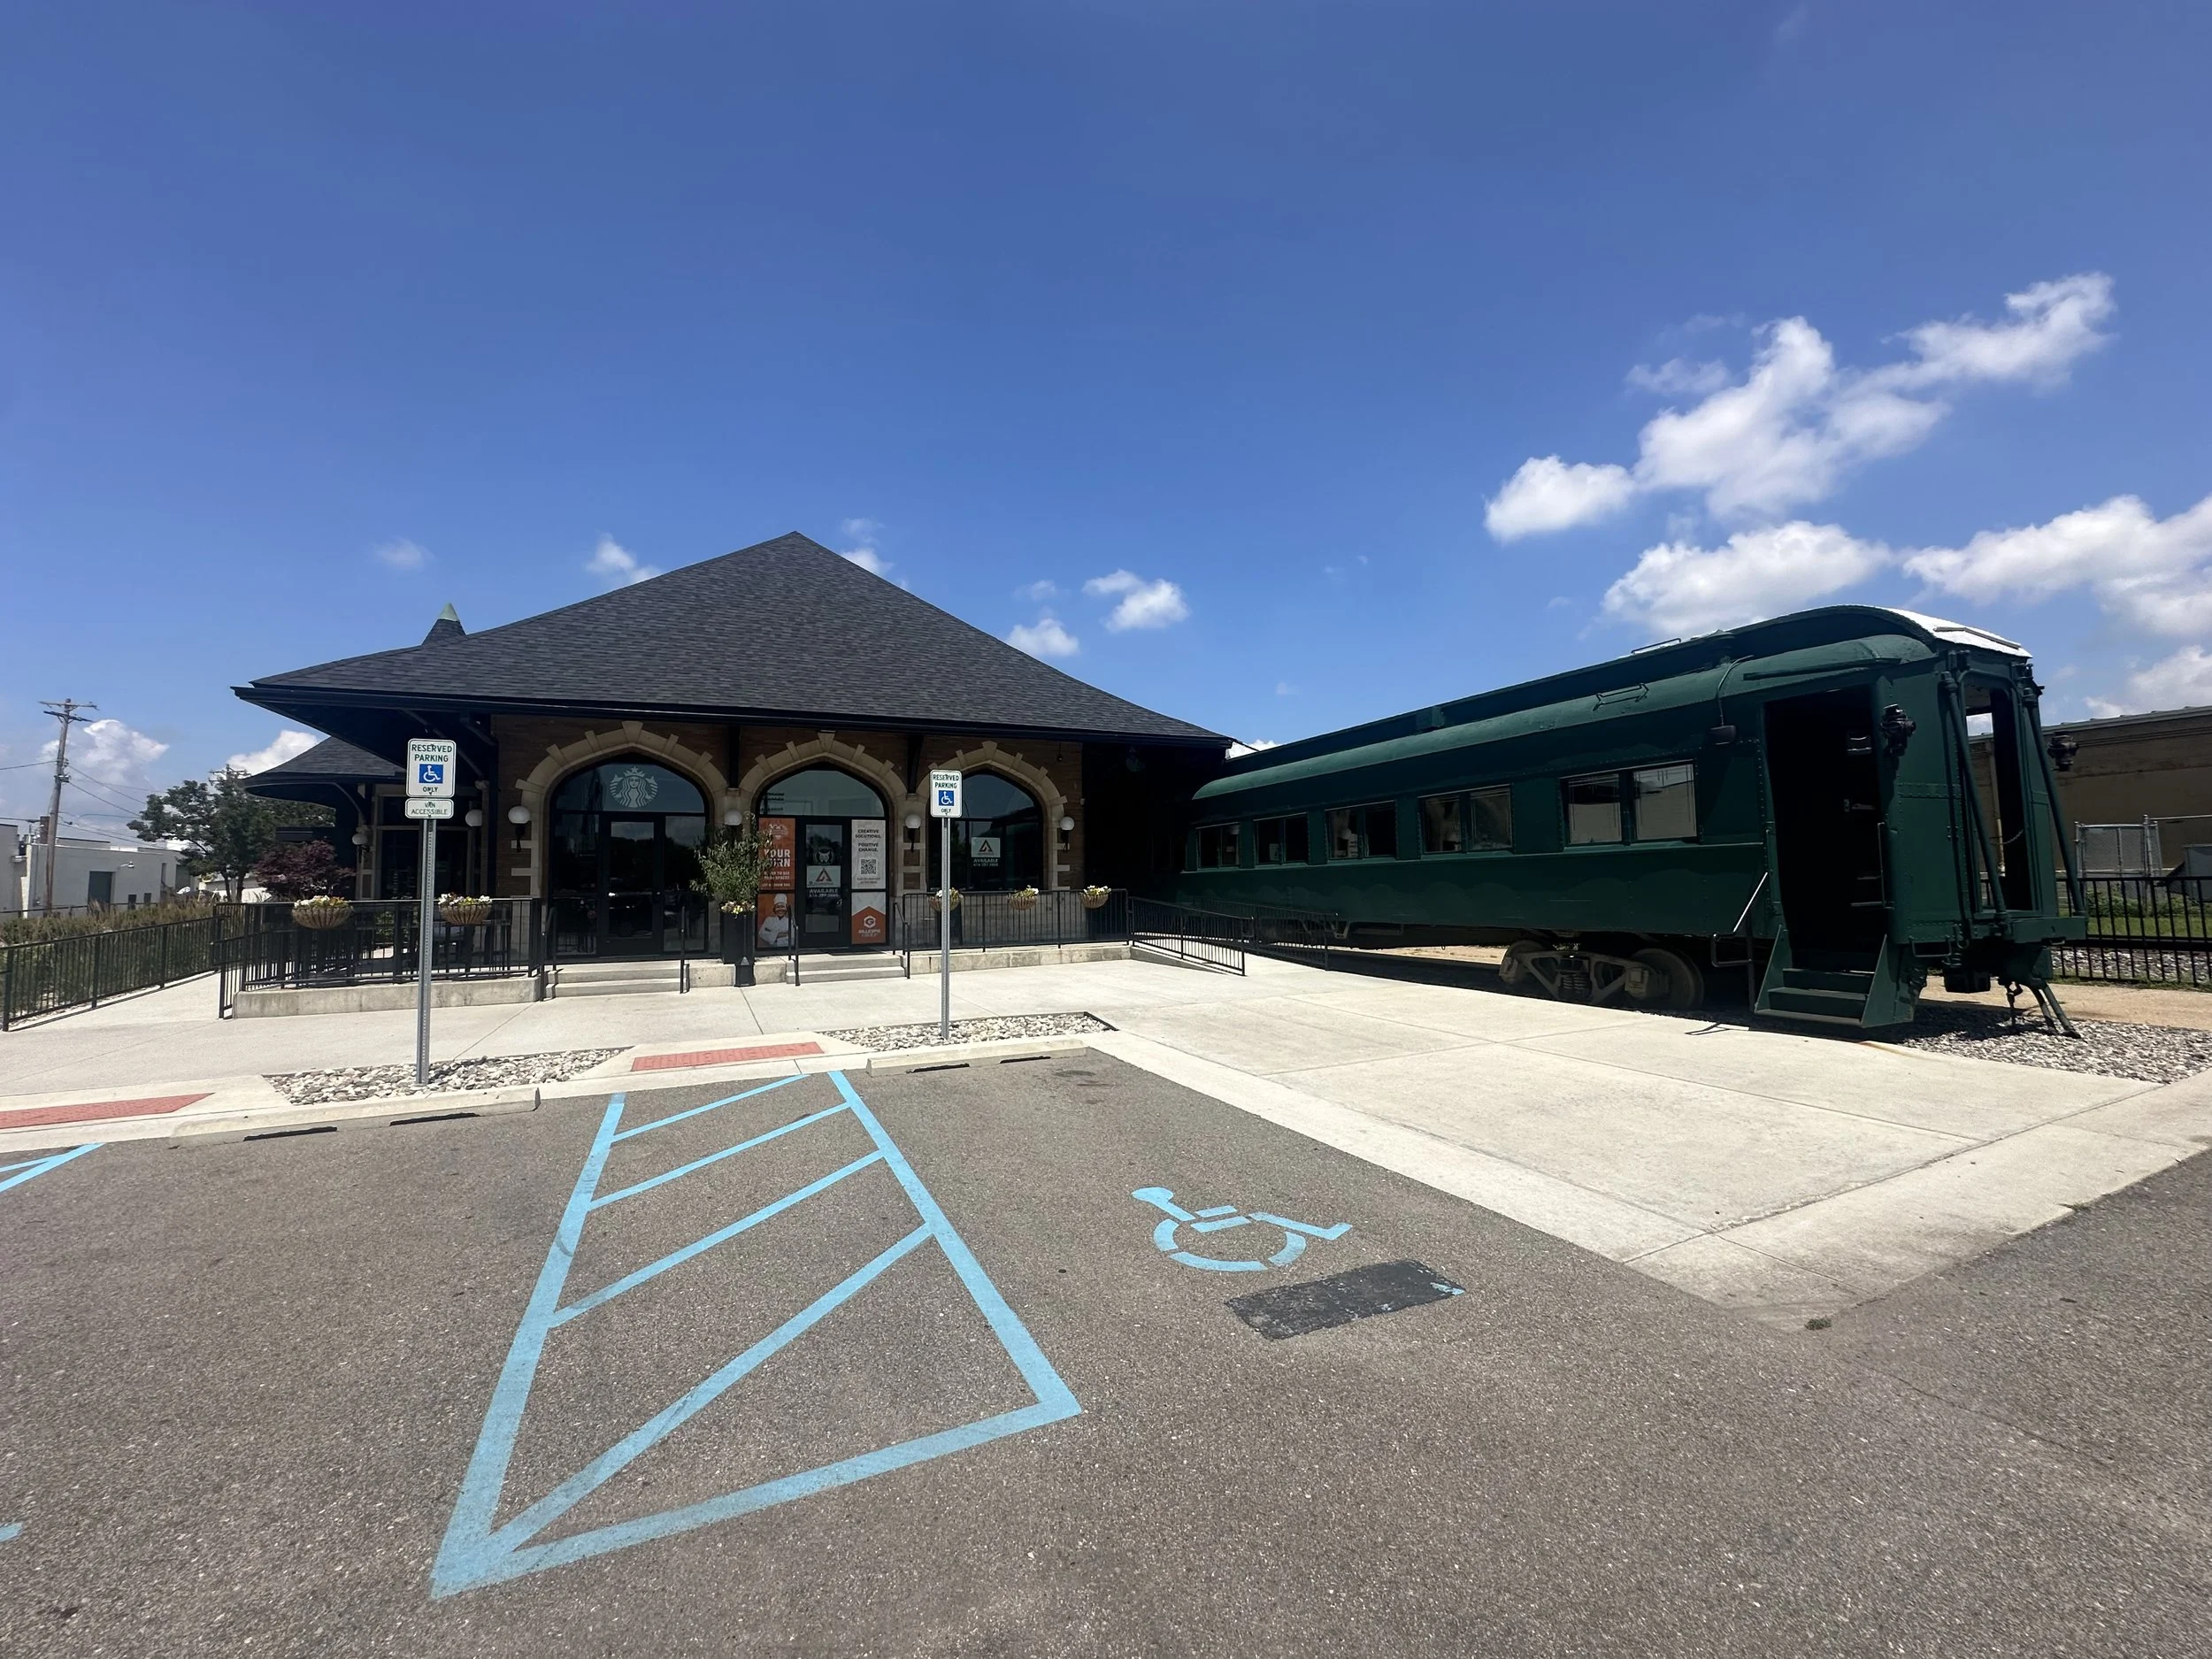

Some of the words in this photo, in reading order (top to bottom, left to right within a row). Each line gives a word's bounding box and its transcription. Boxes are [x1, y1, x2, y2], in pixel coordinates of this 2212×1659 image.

[411, 744, 452, 753] RESERVED
[414, 754, 449, 763] PARKING
[764, 849, 791, 858] YOUR
